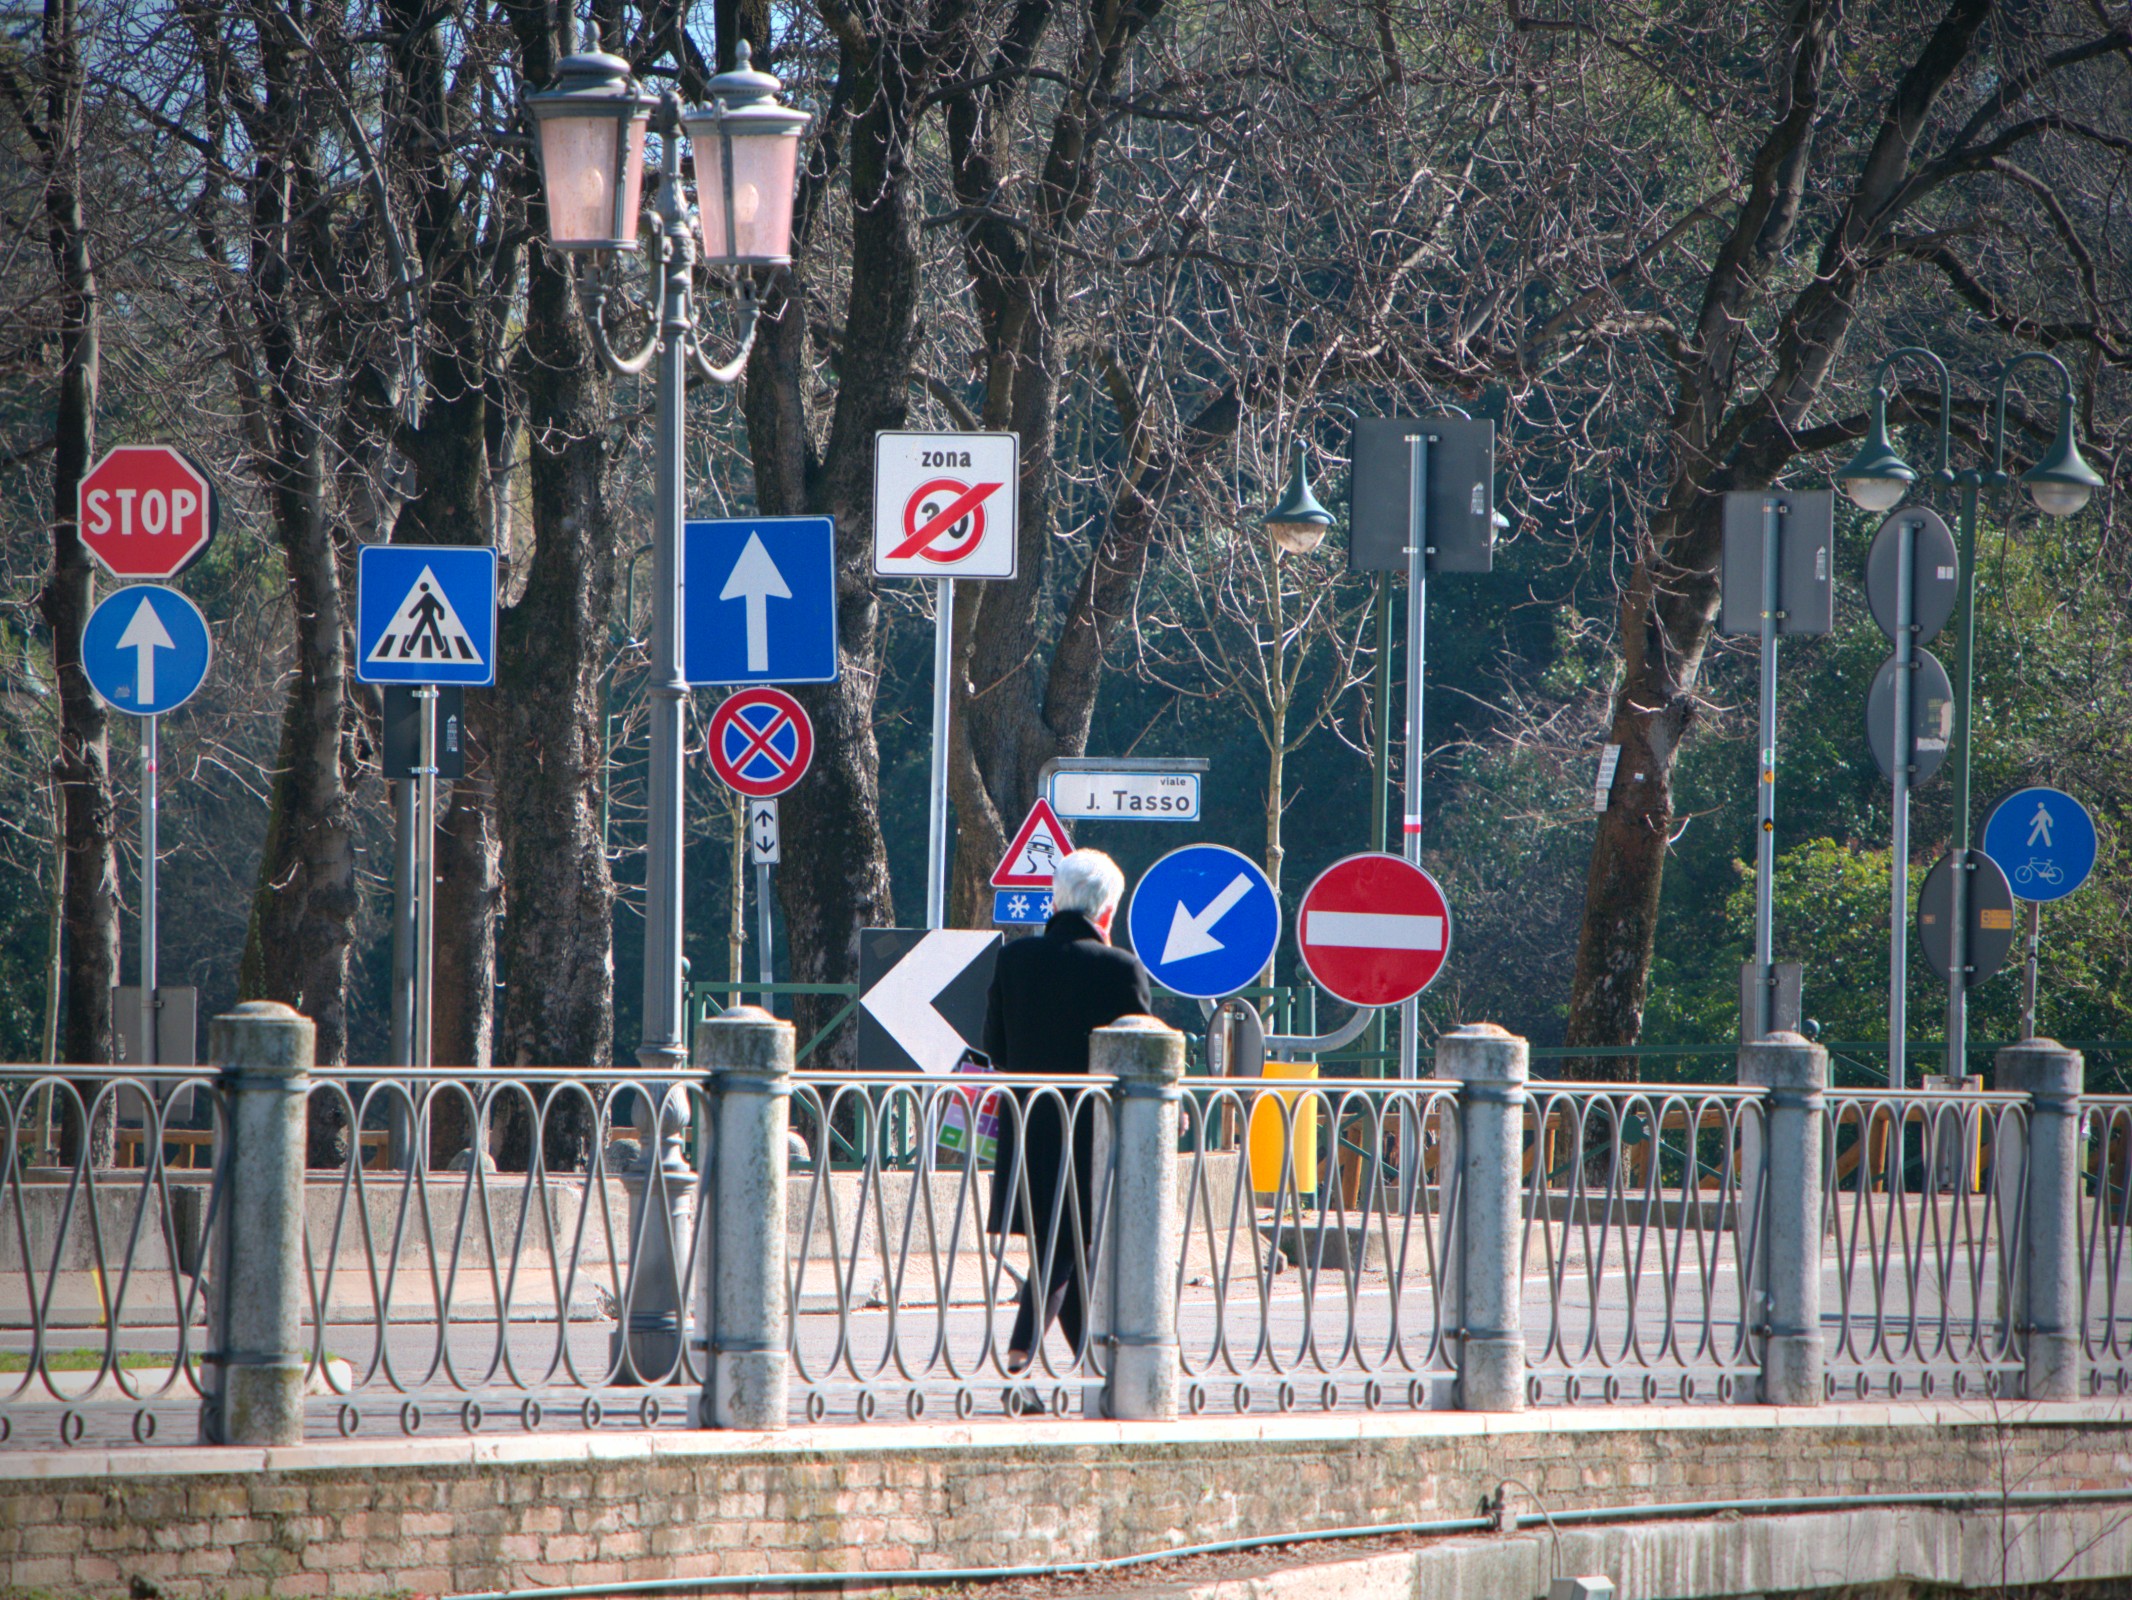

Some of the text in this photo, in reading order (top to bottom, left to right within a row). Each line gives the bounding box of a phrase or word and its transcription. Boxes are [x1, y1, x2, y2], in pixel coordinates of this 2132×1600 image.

[921, 451, 972, 468] zona
[86, 488, 197, 535] STOP
[1160, 777, 1186, 786] viale
[1086, 790, 1190, 811] J. Tasso
